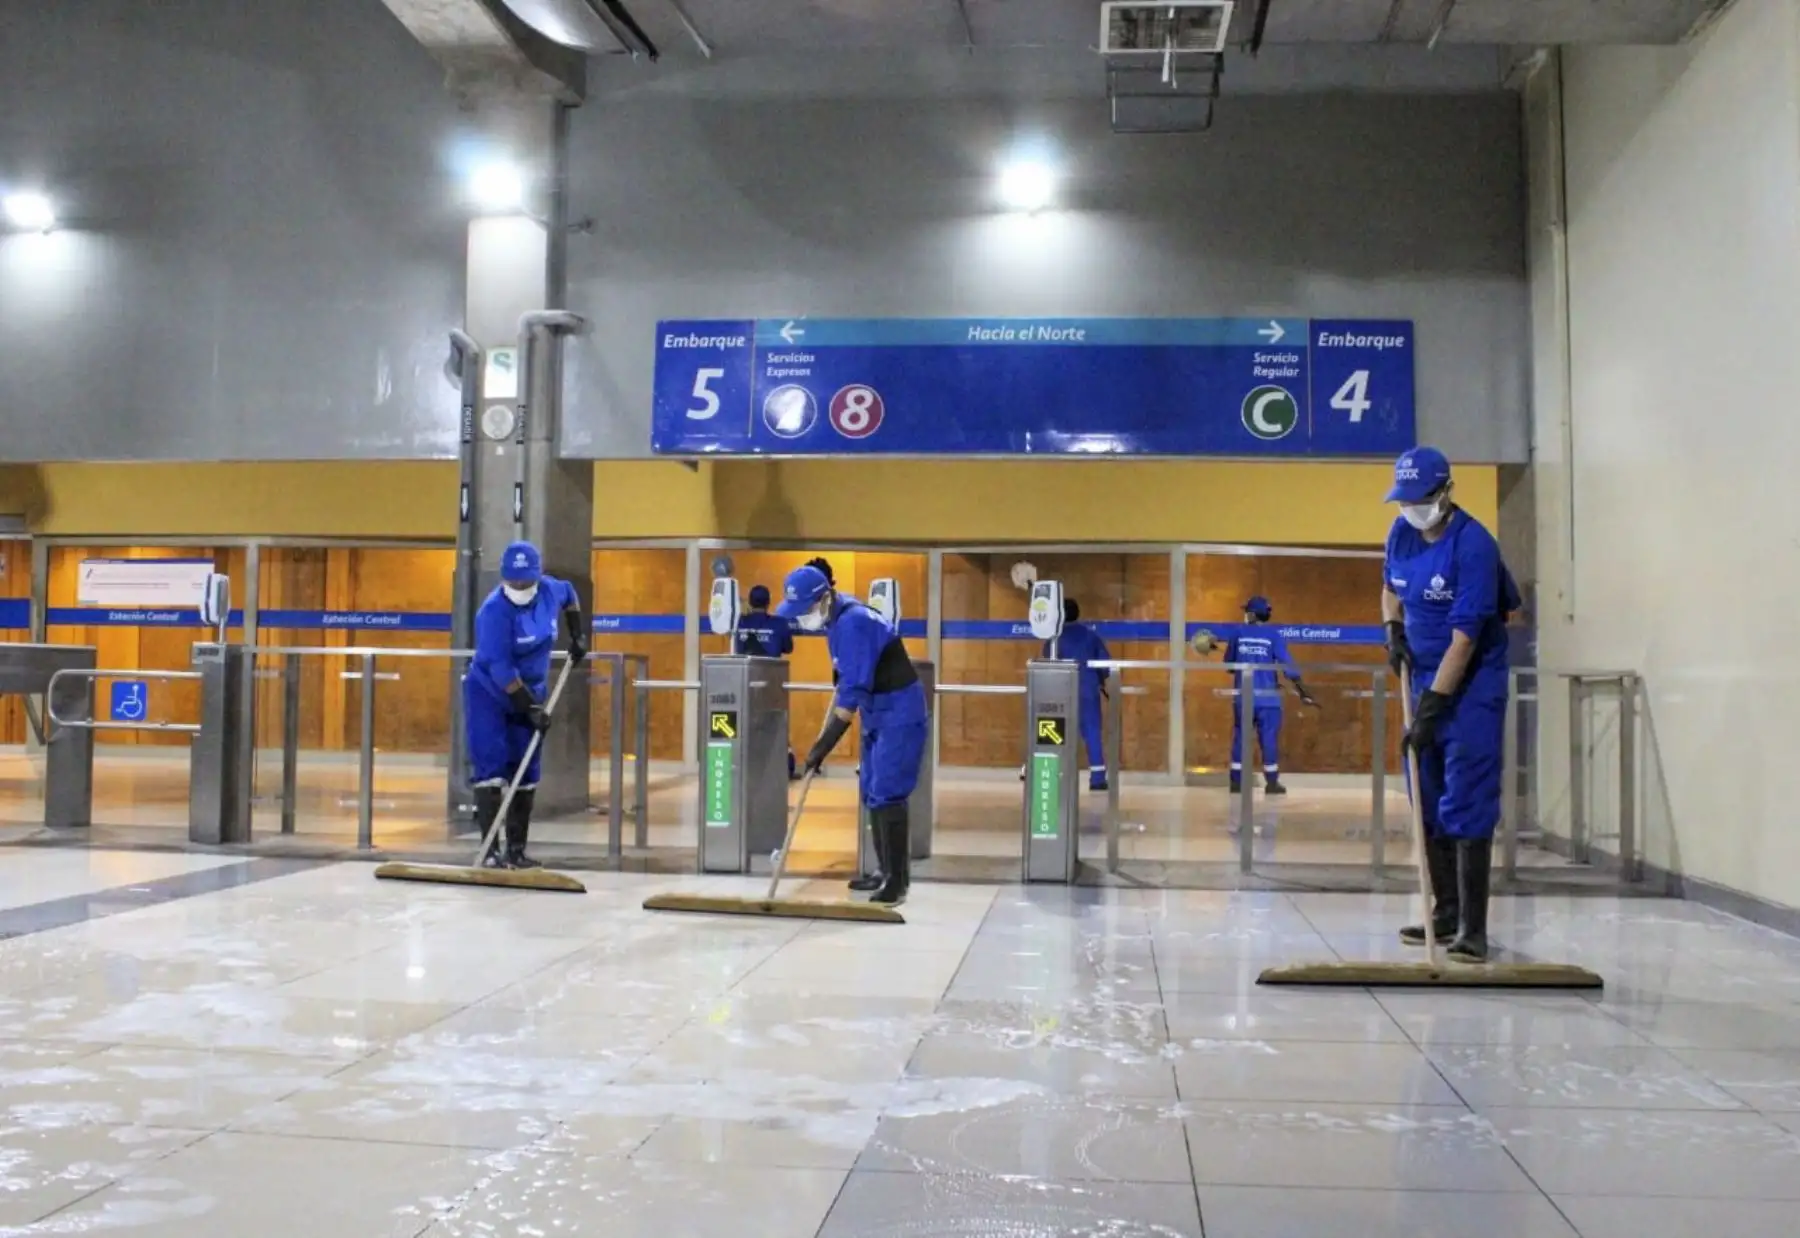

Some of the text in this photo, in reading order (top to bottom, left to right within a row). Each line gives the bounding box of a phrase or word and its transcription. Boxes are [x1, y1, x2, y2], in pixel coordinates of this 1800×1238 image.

[1018, 325, 1034, 341] el
[1037, 325, 1086, 341] Norte
[1317, 331, 1405, 351] Embarque
[663, 332, 746, 351] Embarque
[766, 352, 815, 364] Servicios
[1252, 352, 1299, 364] Servicio
[766, 366, 811, 378] Expresos
[1253, 366, 1300, 379] Regular
[685, 367, 725, 421] 5
[1329, 369, 1372, 423] 4
[839, 388, 874, 431] 8
[1252, 391, 1287, 433] C
[365, 614, 401, 625] Central
[1302, 627, 1341, 638] Central
